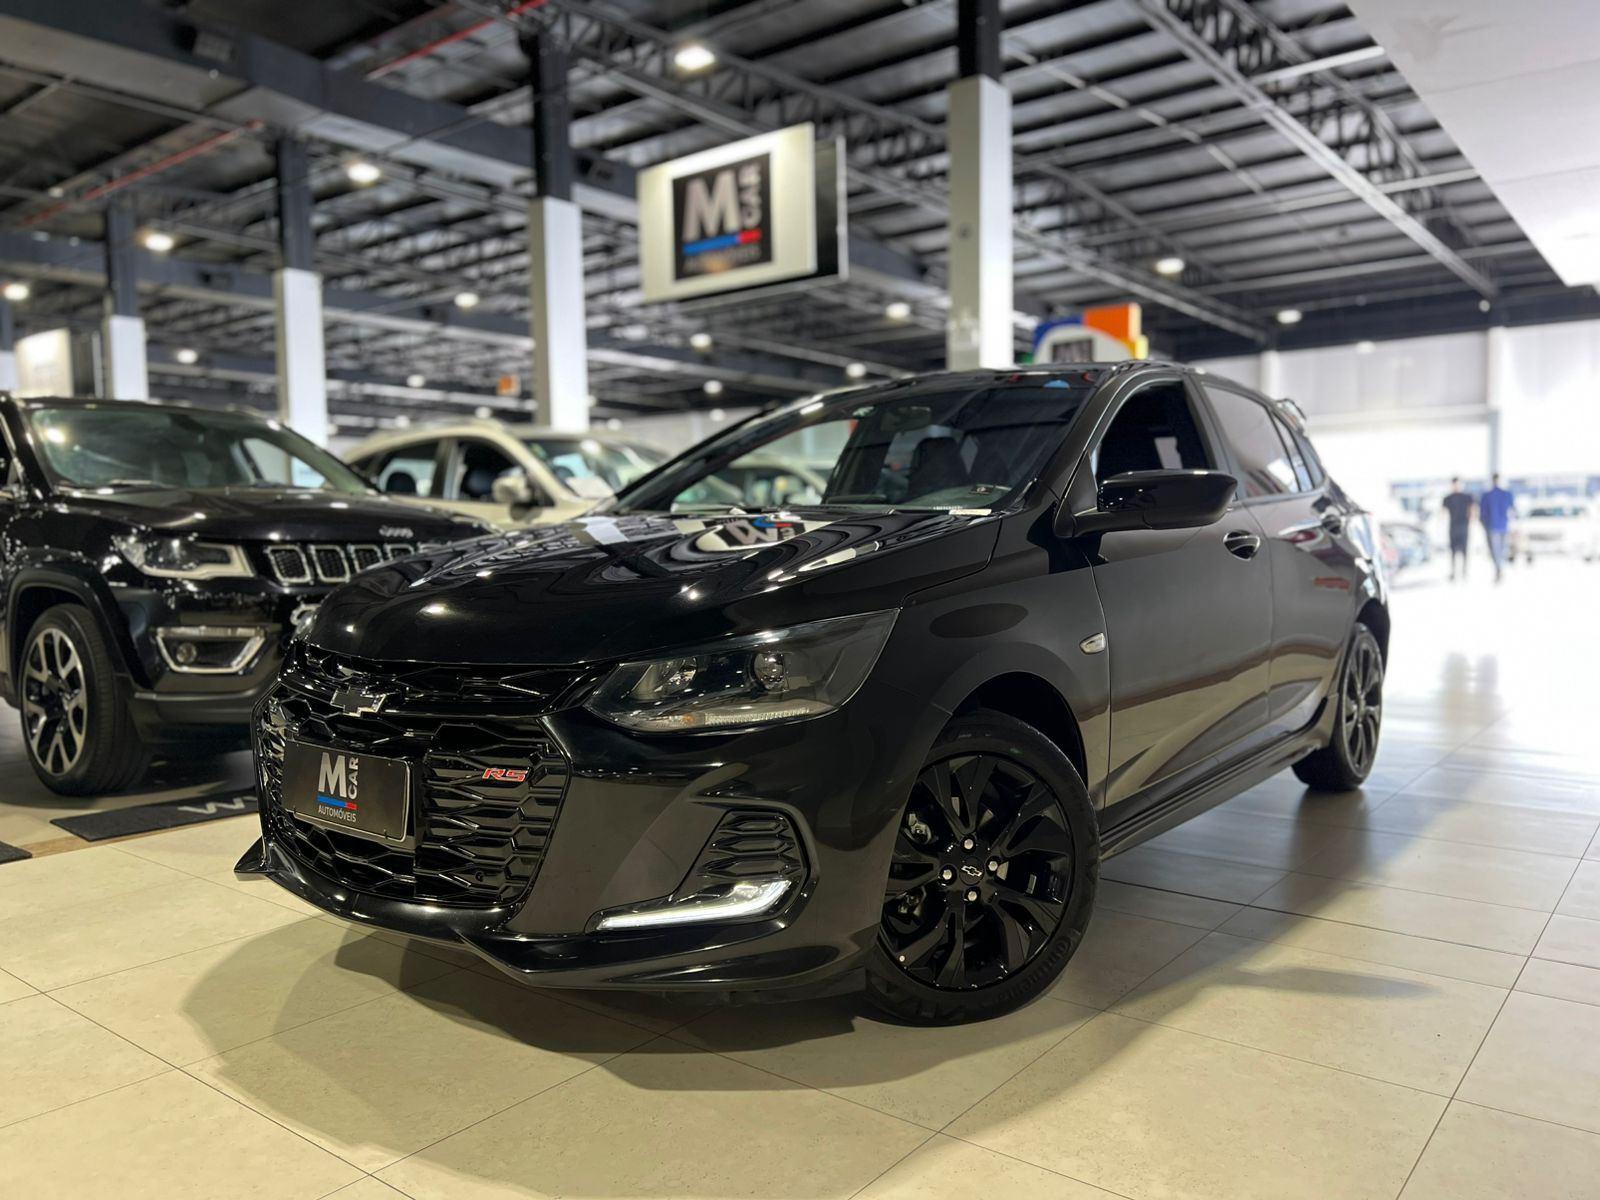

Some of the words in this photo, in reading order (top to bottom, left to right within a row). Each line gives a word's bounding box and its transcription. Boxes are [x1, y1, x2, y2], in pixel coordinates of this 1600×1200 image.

[682, 169, 740, 242] M
[318, 752, 347, 797] M
[348, 757, 359, 800] CAR
[482, 767, 528, 782] RS
[318, 804, 357, 823] AUTOMÓVEIS
